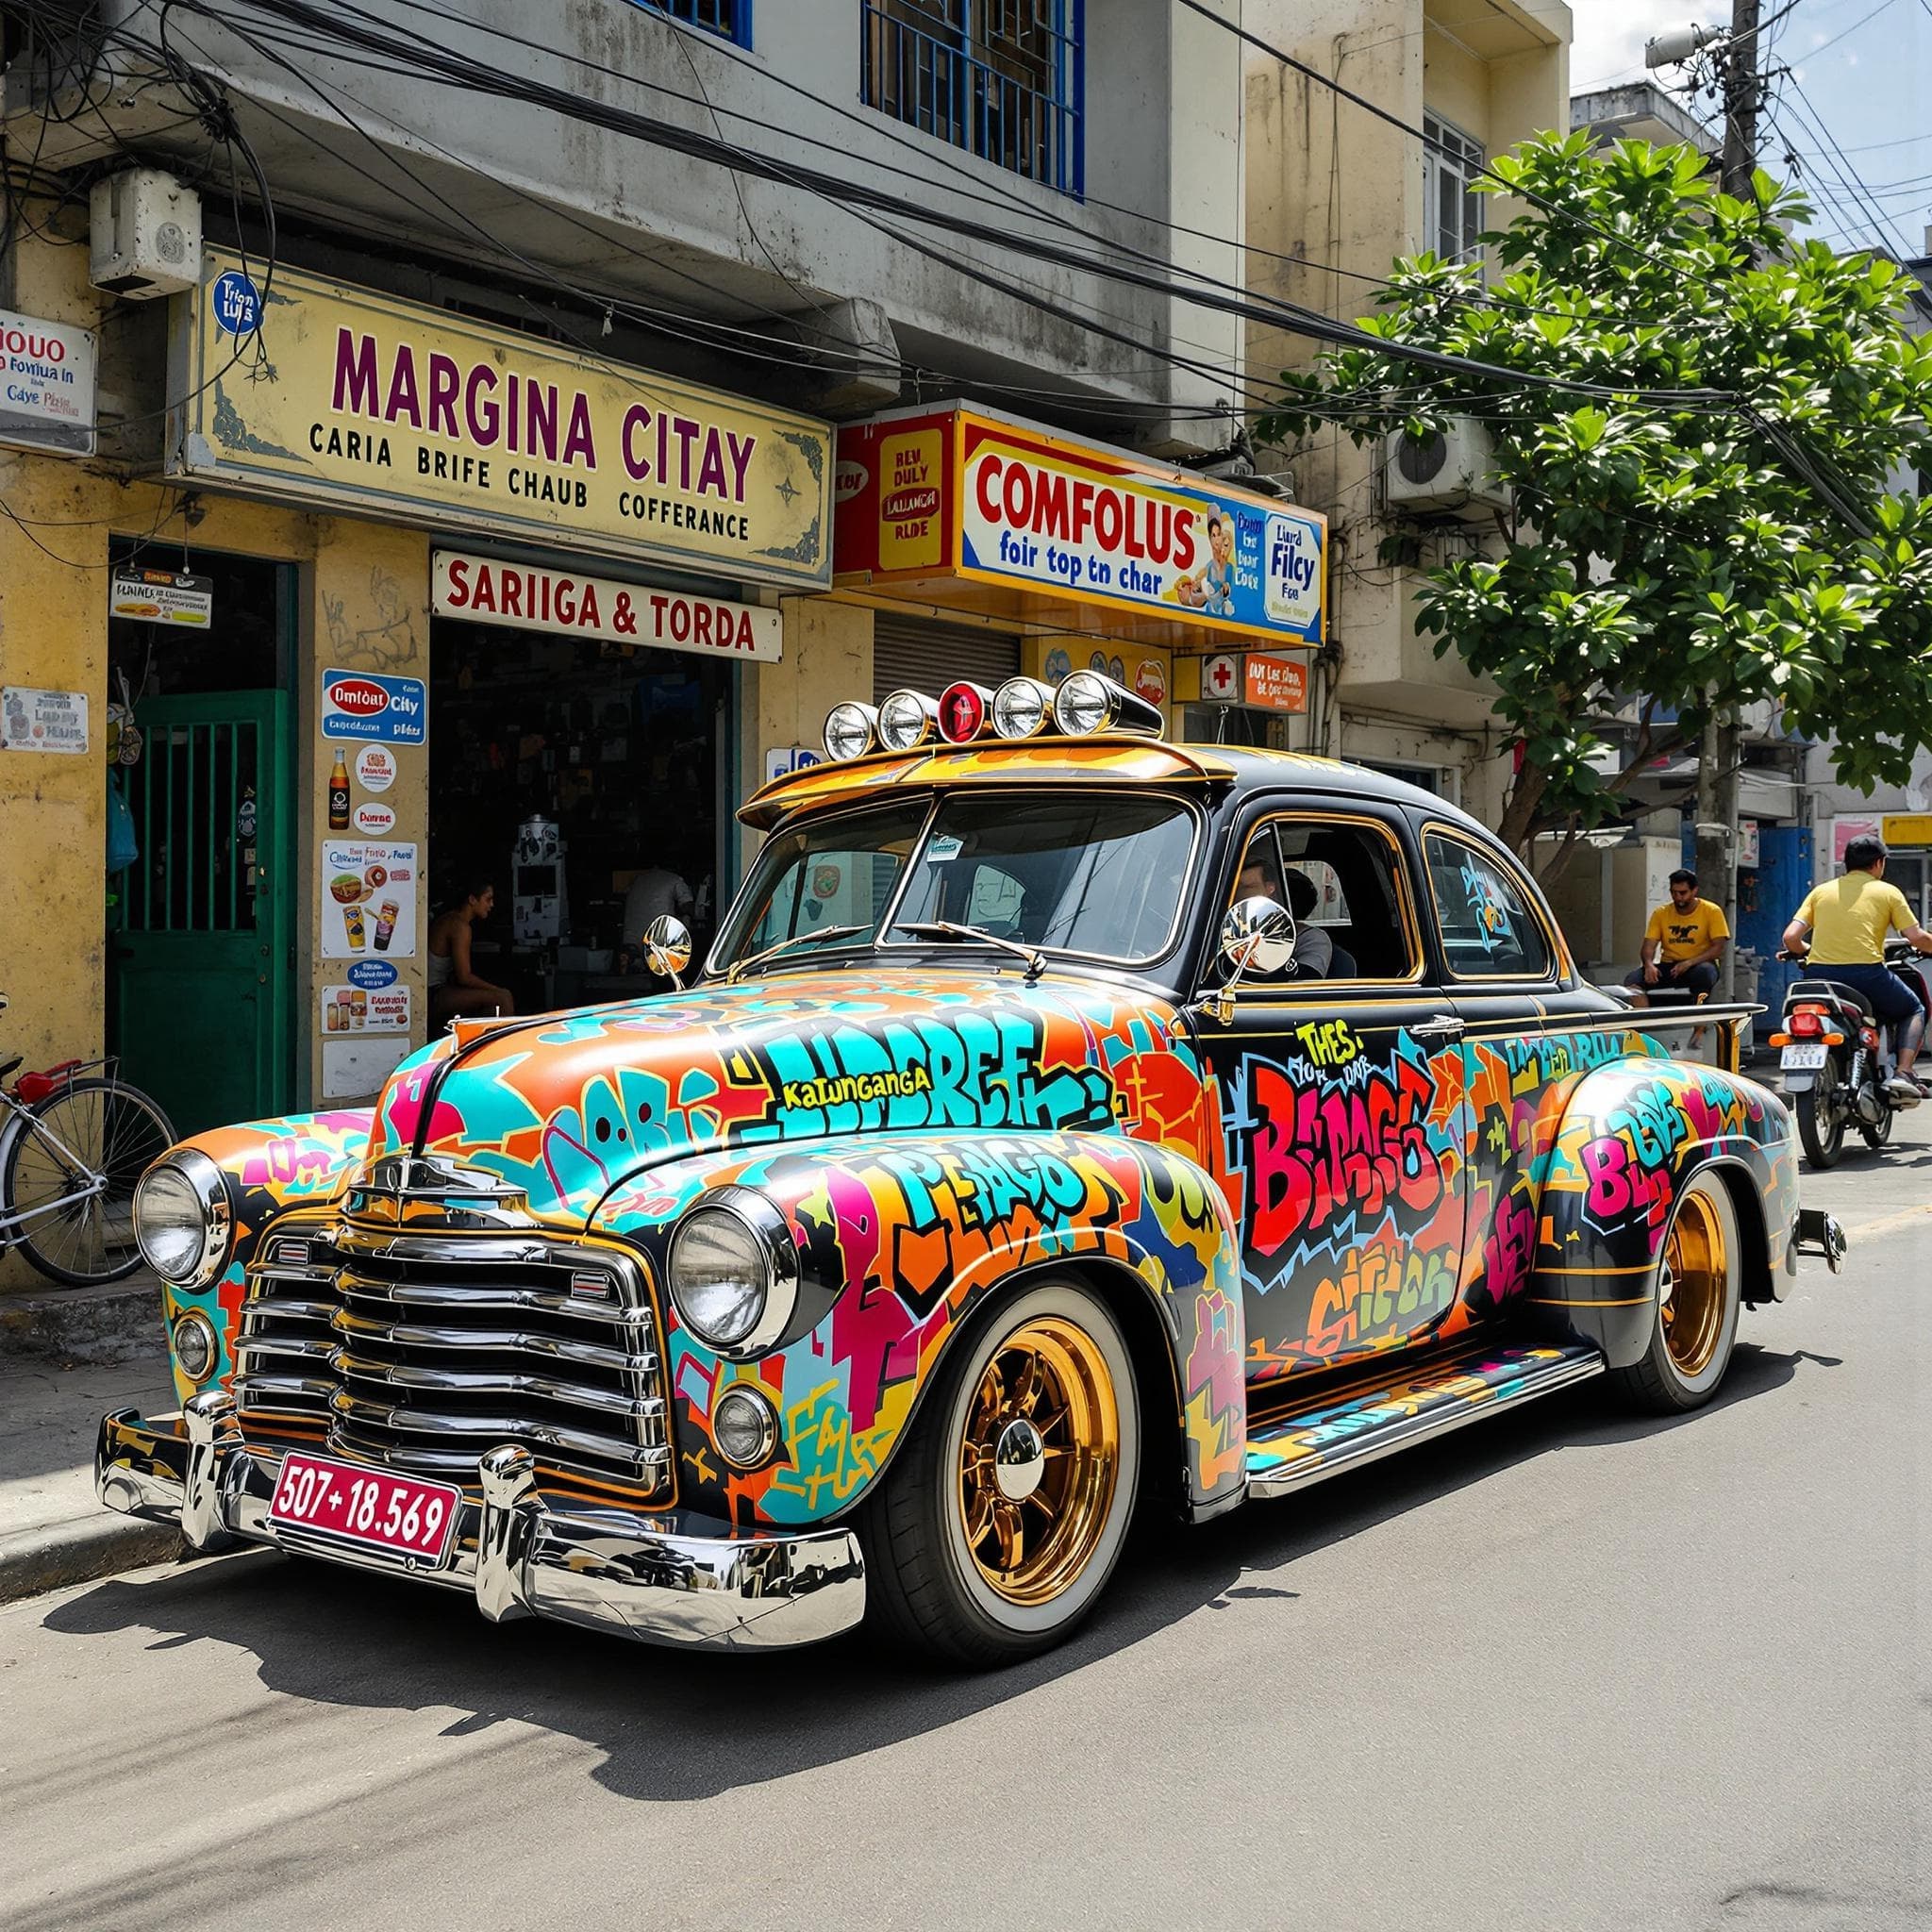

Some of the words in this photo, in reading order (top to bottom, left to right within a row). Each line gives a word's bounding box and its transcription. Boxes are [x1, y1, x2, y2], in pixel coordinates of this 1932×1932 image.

[331, 326, 597, 470] MARGINA
[621, 403, 757, 504] CITAY
[309, 423, 392, 468] CARIA
[417, 446, 491, 490] BRIFE
[508, 468, 589, 508] CHAUB
[618, 491, 750, 541] COFFERANCE
[975, 454, 1196, 571] COMFOLUS
[446, 558, 602, 629] SARIIGA
[613, 590, 638, 635] &
[650, 595, 756, 652] TORDA
[999, 528, 1039, 568] foir
[1046, 543, 1083, 587] top
[1119, 560, 1163, 596] char
[1271, 542, 1316, 591] Filcy
